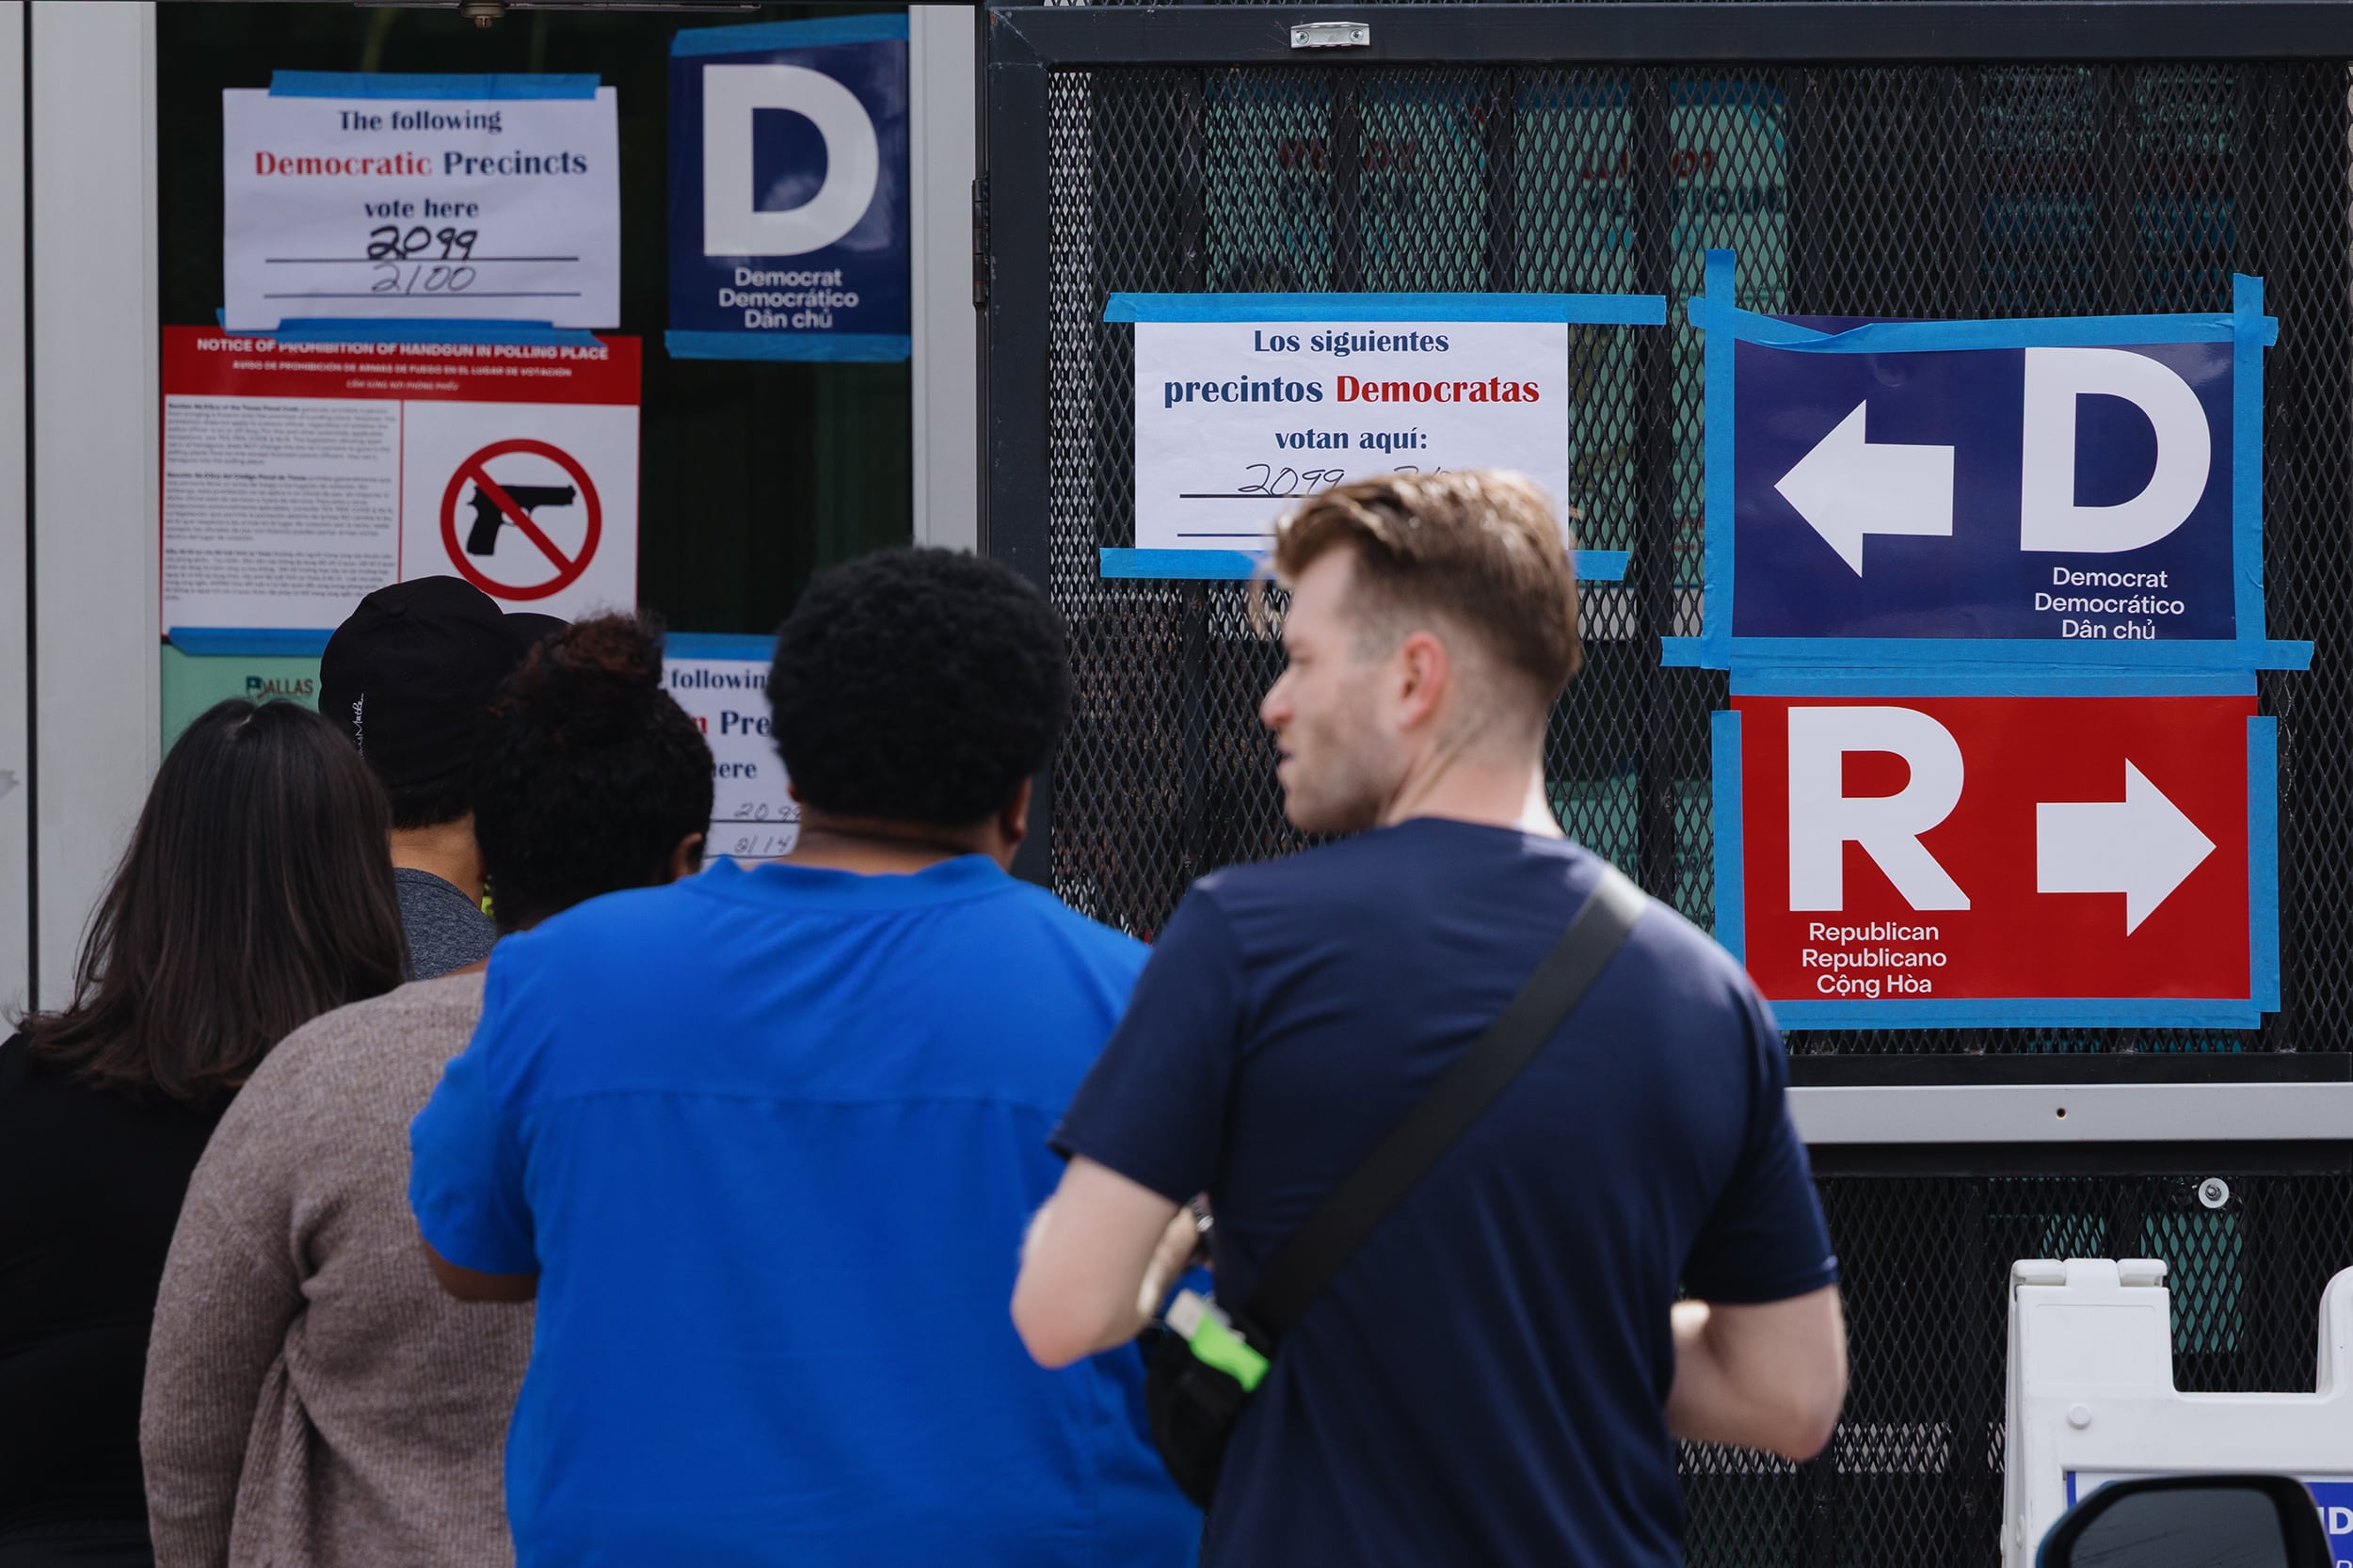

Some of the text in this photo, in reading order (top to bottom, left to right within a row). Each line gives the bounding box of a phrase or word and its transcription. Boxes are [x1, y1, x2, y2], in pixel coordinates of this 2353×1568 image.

[339, 110, 502, 135] The following
[255, 151, 588, 176] Democratic Precincts
[703, 64, 879, 256] D
[364, 199, 480, 218] vote here
[367, 225, 478, 260] 2099
[371, 263, 476, 296] 2100
[735, 267, 842, 287] Democrat
[718, 288, 859, 309] Democrático
[744, 307, 833, 328] Dân chủ
[197, 339, 609, 360] NOTICE OF PROHIBITION OF HANDGUN IN POLLING PLACE
[1254, 329, 1449, 357] Los siguientes
[1164, 375, 1540, 408] precintos Democratas
[1275, 428, 1427, 454] votan aquí:
[2020, 347, 2211, 553] D
[2053, 567, 2168, 588] Democrat
[2035, 592, 2185, 615] Democrático
[2062, 618, 2155, 639] Dân chủ
[671, 669, 769, 689] followin
[1787, 706, 1971, 911] R
[1809, 921, 1940, 946] Republican
[1801, 949, 1947, 971] Republicano
[1817, 973, 1932, 999] Cộng Hòa
